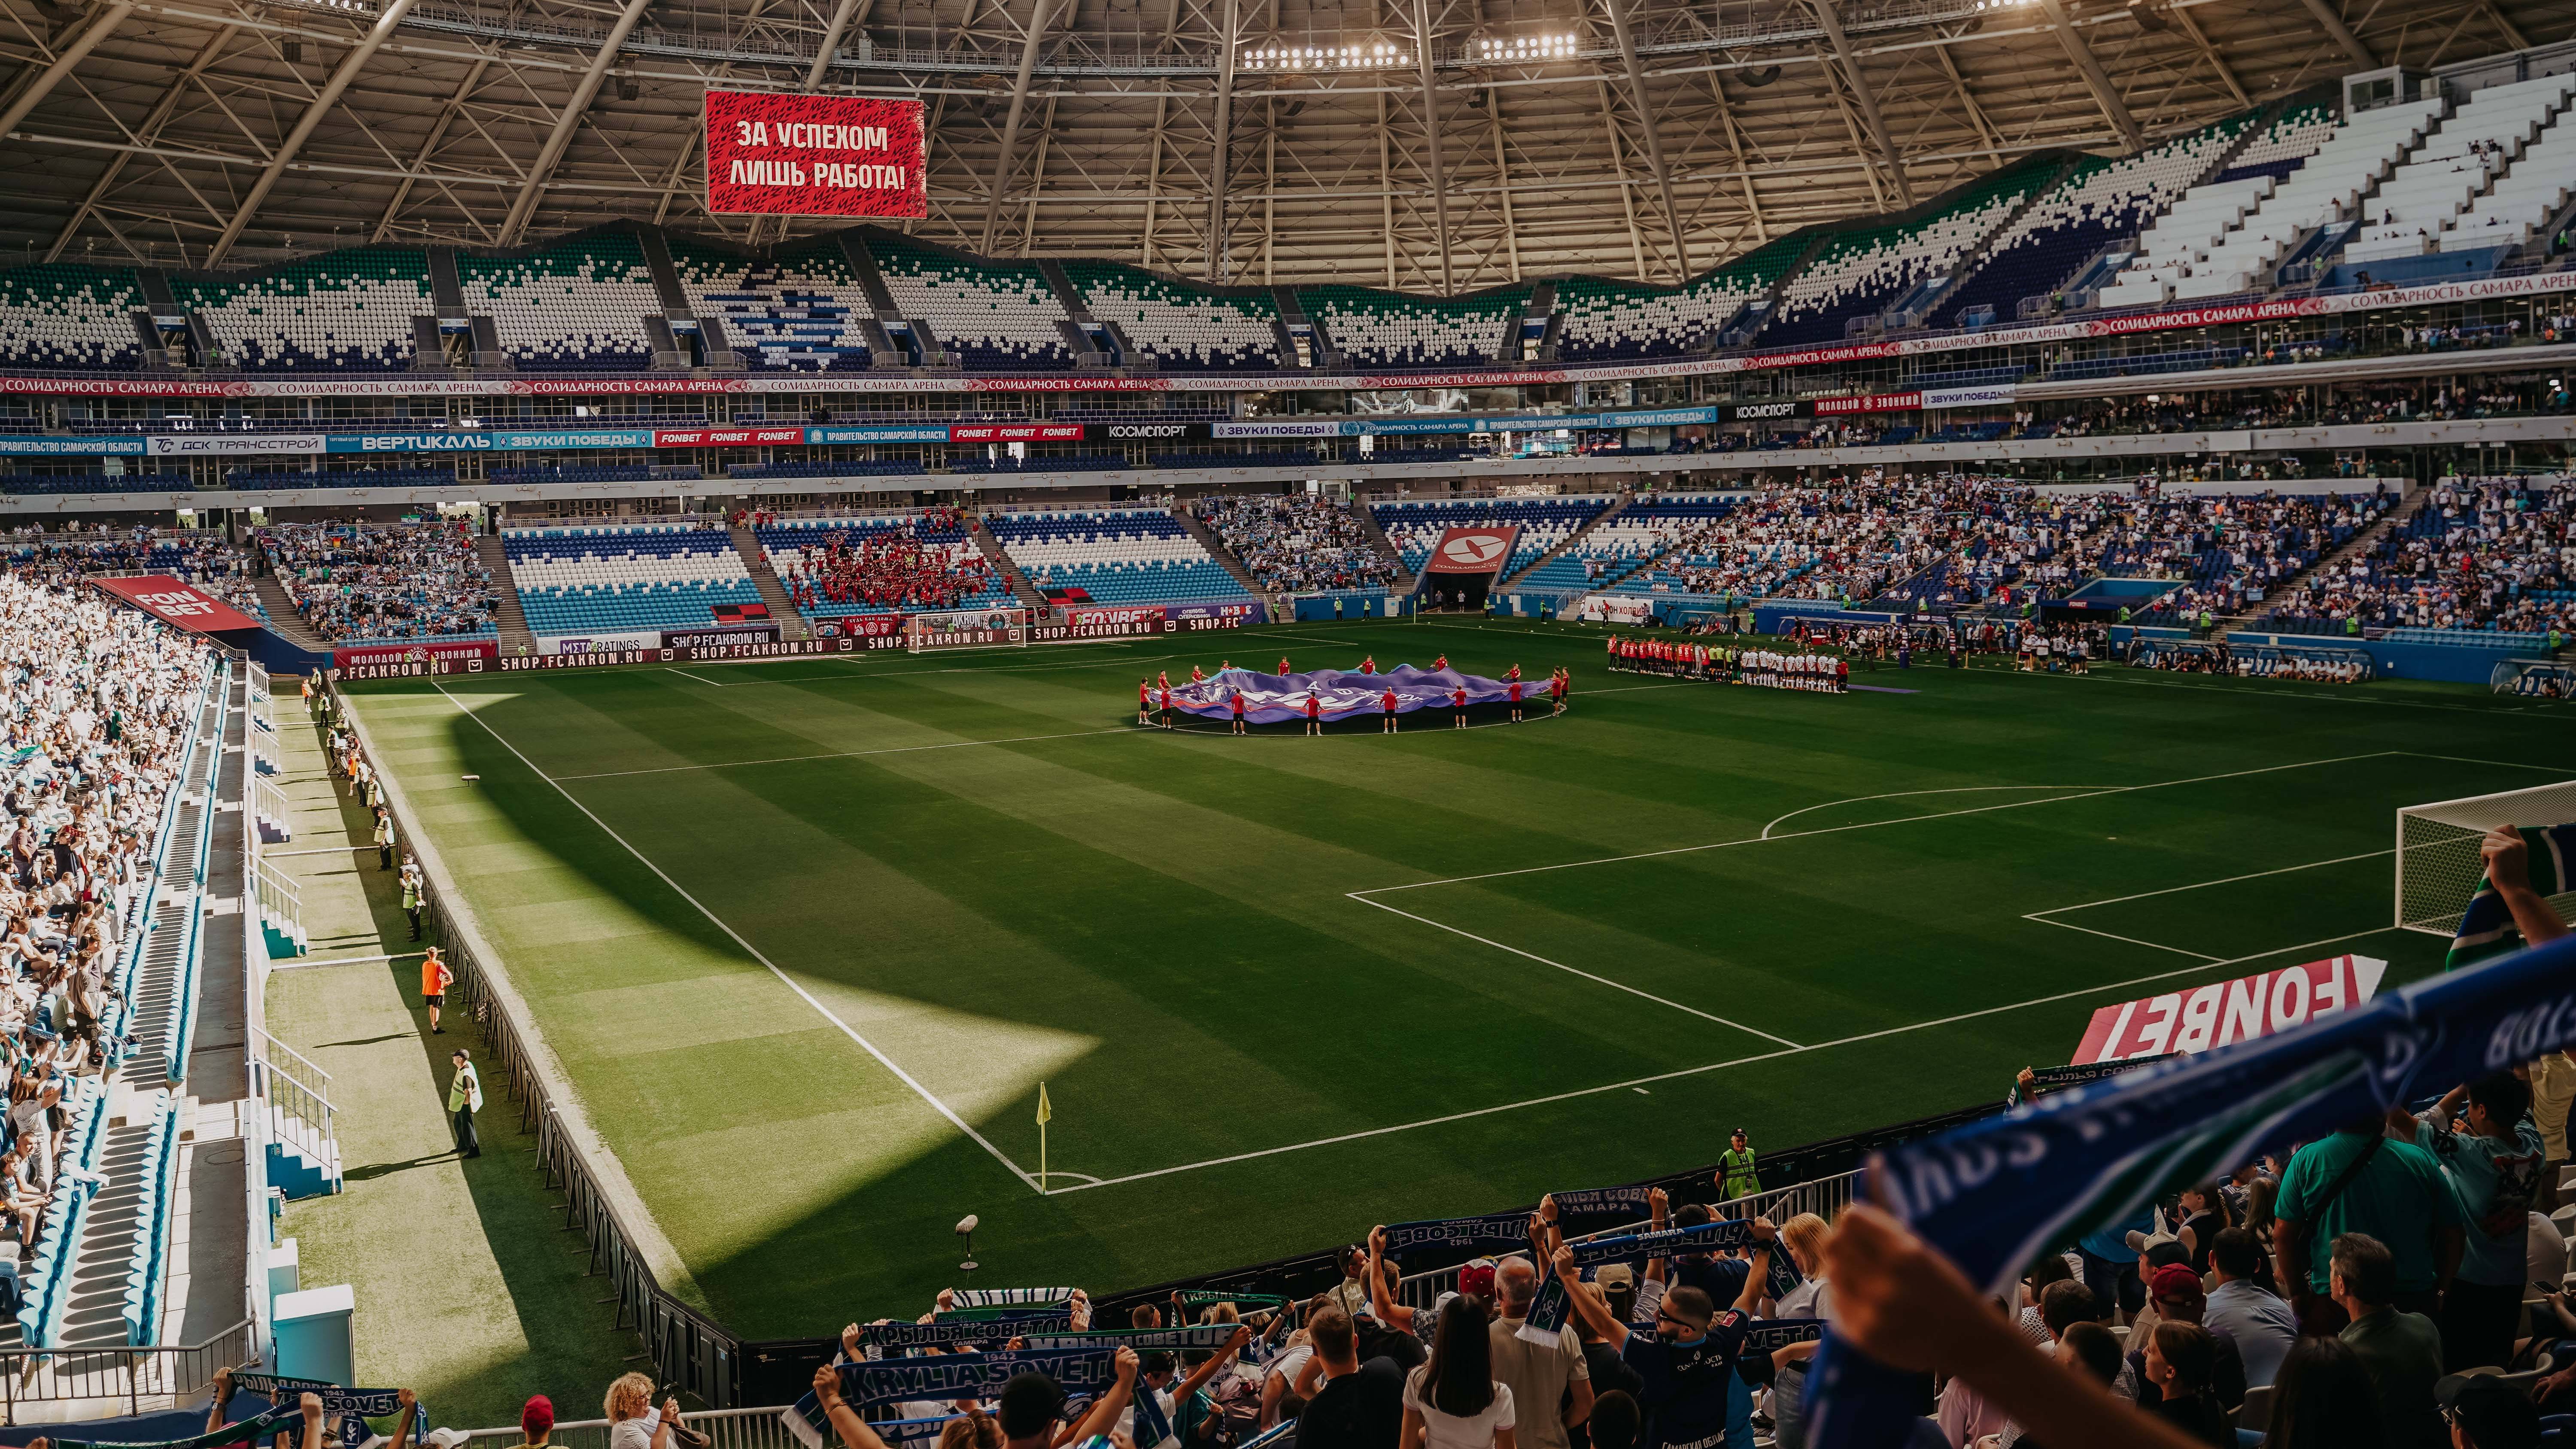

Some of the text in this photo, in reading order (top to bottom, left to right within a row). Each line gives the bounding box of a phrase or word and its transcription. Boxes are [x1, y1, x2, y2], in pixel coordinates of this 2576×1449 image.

[737, 121, 888, 151] ЗА УСПЕХОМ
[730, 160, 905, 190] ЛИШЬ РАБОТА!
[2470, 277, 2532, 294] САМАРА
[2110, 303, 2296, 331] СОЛИДАРНОСТЬ САМАРА АРЕНА
[2038, 328, 2067, 339] АРЕНА
[1759, 346, 1883, 368] СОЛИДАРНОСТЬ САМАРА АРЕНА
[1583, 361, 1727, 379] СОЛИДАРНОСТЬ САМАРА АРЕНА
[771, 380, 945, 391] СОЛИДАРНОСТЬ САМАРА АРЕНА
[988, 380, 1070, 390] СОЛИДАРНОСТЬ
[1073, 378, 1115, 389] САМАРА
[1189, 378, 1340, 388] СОЛИДАРНОСТЬ САМАРА АРЕНА
[1382, 372, 1543, 386] СОЛИДАРНОСТЬ САМАРА АРЕНА
[6, 380, 113, 393] СОЛИДАРНОСТЬ
[118, 382, 175, 393] САМАРА
[277, 383, 383, 394] СОЛИДАРНОСТЬ
[445, 383, 483, 392] АРЕНА
[534, 380, 723, 393] СОЛИДАРНОСТЬ САМАРА АРЕНА
[1818, 394, 1919, 411] МОЛОДОЙ ЗВОНКИЙ
[1931, 394, 1962, 403] ЗВУКИ
[1489, 417, 1598, 429] ПРАВИТЕЛЬСТВО САМАРСКОЙ ОБЛАСТИ
[1614, 411, 1705, 425] ЗВУКИ ПОБЕДЫ
[957, 430, 993, 438] FONBET
[1000, 429, 1035, 437] FONBET
[1042, 428, 1078, 437] FONBET
[1227, 425, 1325, 435] ЗВУКИ ПОБЕДЫ
[1365, 424, 1416, 432] СОЛИДАРНОСТЬ
[510, 434, 637, 447] ЗВУКИ ПОБЕДЫ
[662, 434, 702, 443] FONBET
[710, 433, 750, 441] FONBET
[758, 431, 796, 440] FONBET
[827, 429, 946, 441] ПРАВИТЕЛЬСТВО САМАРСКОЙ ОБЛАСТИ
[61, 440, 106, 452] САМАРСКОЙ
[107, 440, 143, 452] ОБЛАСТИ
[181, 437, 318, 451] ДСК ТРАНССТРОЙ
[362, 435, 491, 450] ВЕРТИКАЛЬ
[135, 590, 199, 606] FON
[155, 601, 215, 616] BET
[1598, 605, 1645, 615] АОН ХОЛДИН
[1190, 617, 1239, 630] SHOP.FC
[1035, 622, 1151, 639] SHOP.FCAKRON.RU
[869, 632, 993, 649] SHOP.FCAKRON.RU
[351, 652, 402, 664] МОЛОДОЙ
[434, 648, 481, 659] ЗВОНКИЙ
[691, 640, 823, 659] SHOP.FCAKRON.RU
[501, 650, 643, 670] SHOP.FCAKRON.RU
[1637, 1228, 1685, 1240] SAMARA
[1646, 1249, 1671, 1257] 1942
[867, 1326, 964, 1347] КРЫЛЬЯ
[983, 1352, 1017, 1361] 1942
[845, 1364, 983, 1406] KRYLIA
[978, 1385, 1002, 1396] SAM
